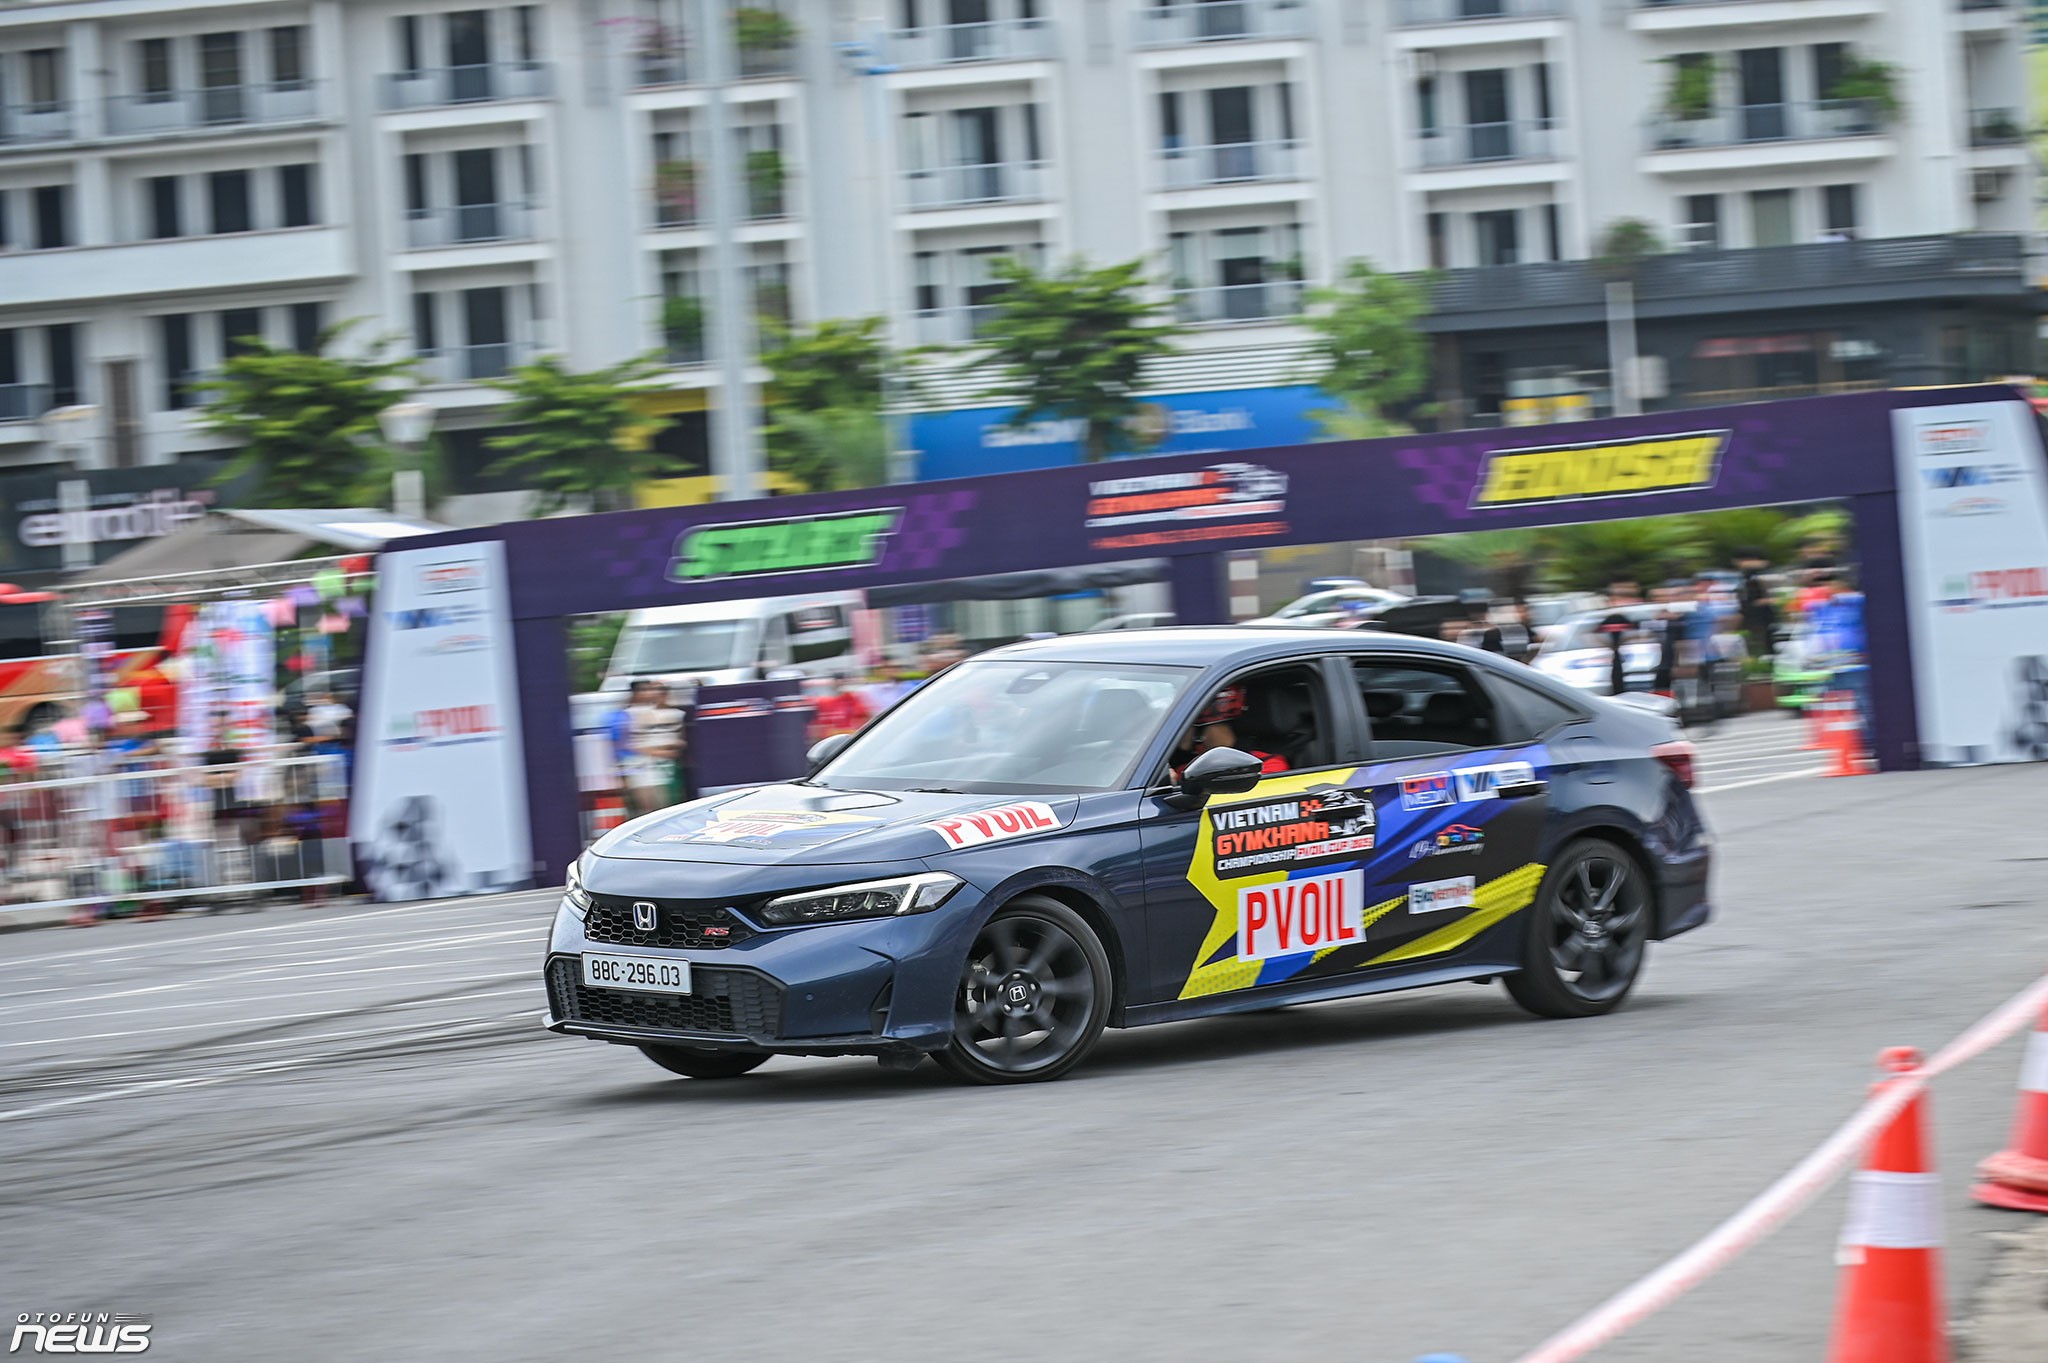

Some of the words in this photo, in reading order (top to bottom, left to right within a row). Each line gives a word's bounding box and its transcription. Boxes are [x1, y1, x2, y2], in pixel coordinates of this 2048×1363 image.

[930, 804, 1053, 844] PVOIL
[1213, 802, 1299, 831] VIETNAM
[1216, 821, 1330, 856] GYMKHANA
[1217, 848, 1296, 871] CHAMPIONSHIP
[704, 927, 730, 936] RS
[1246, 878, 1357, 956] PVOIL
[591, 959, 681, 987] 88C-296.03
